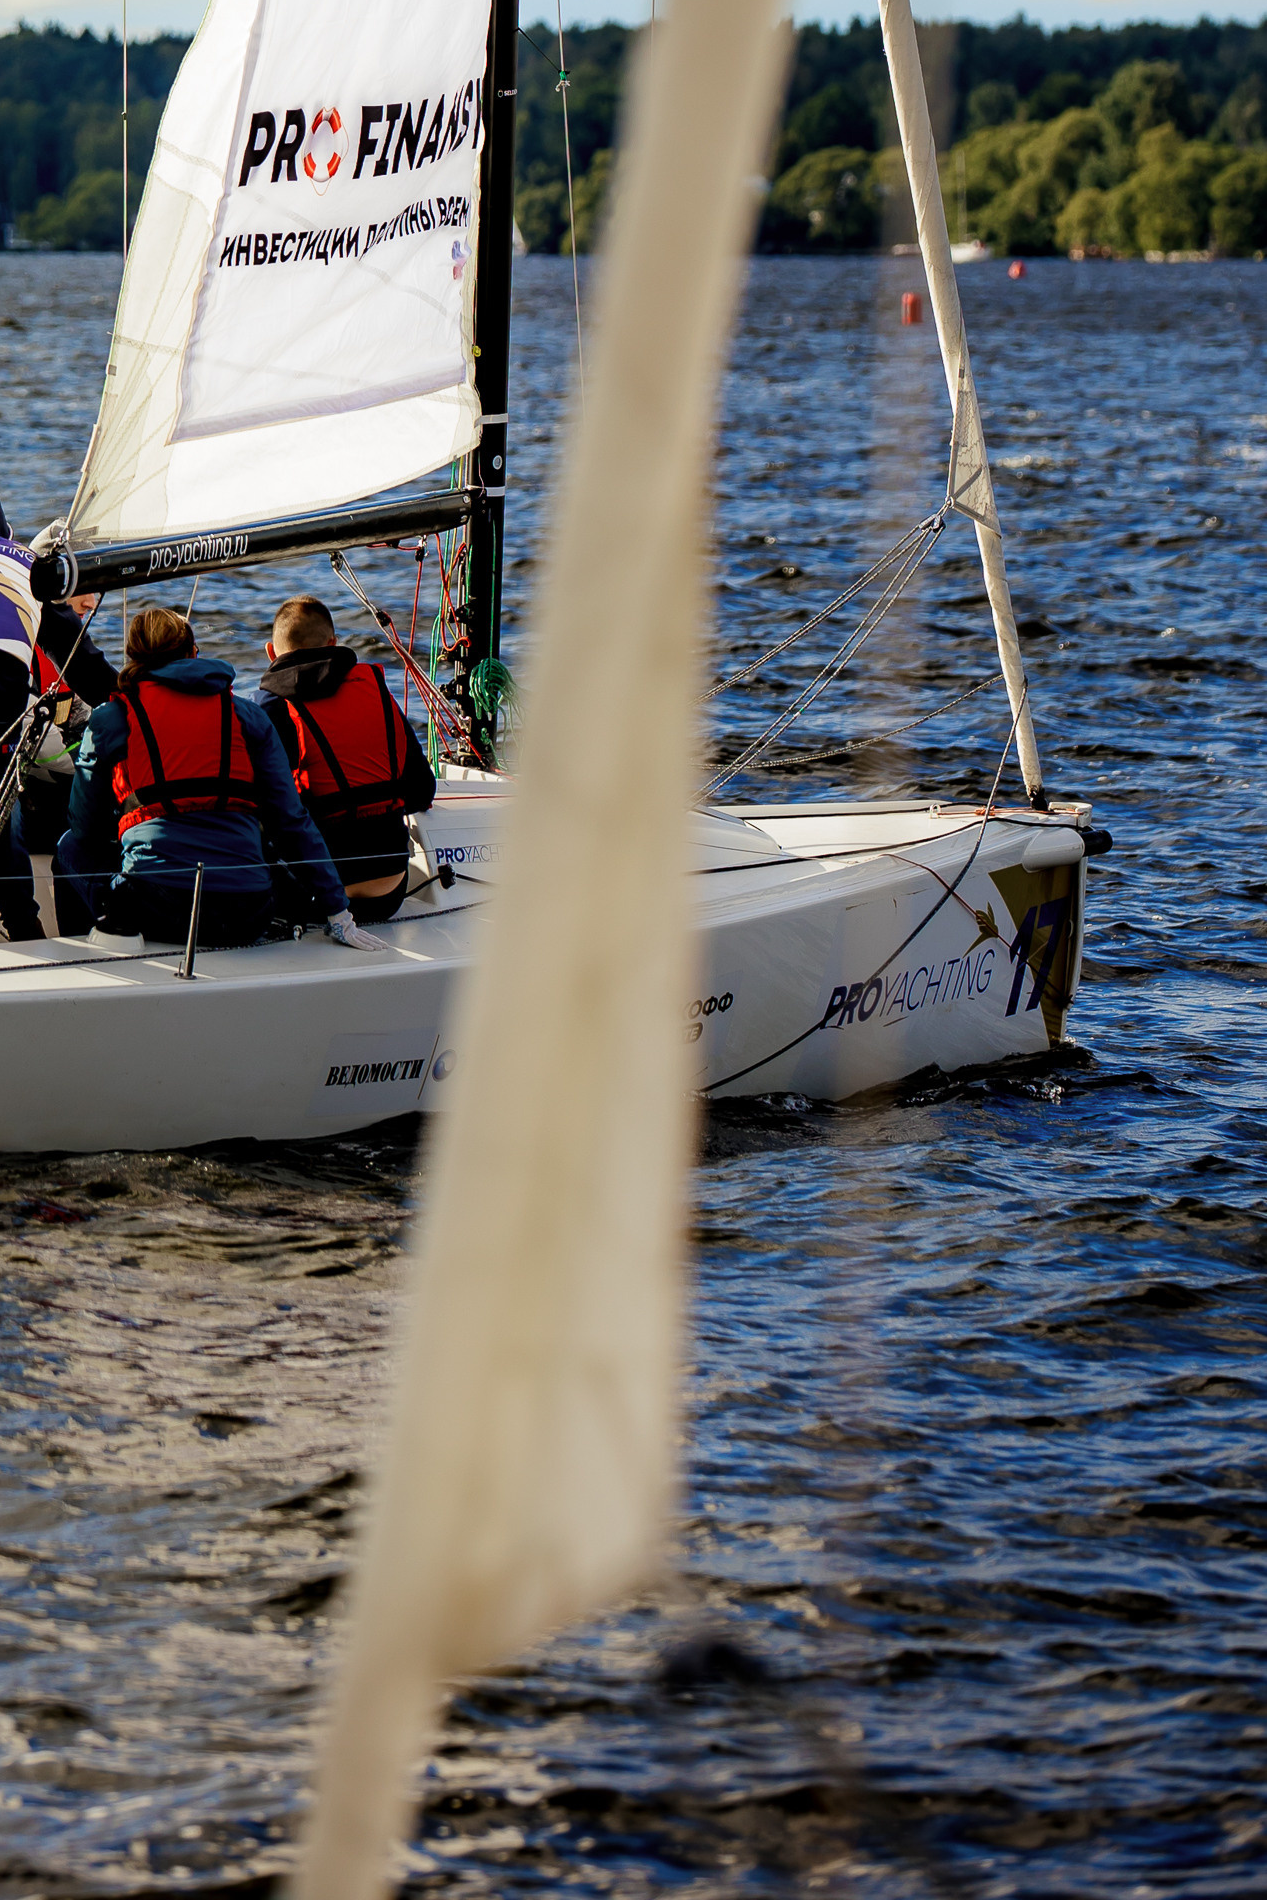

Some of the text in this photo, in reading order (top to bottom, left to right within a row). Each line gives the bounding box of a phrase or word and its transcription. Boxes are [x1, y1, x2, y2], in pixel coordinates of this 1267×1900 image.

[219, 226, 361, 268] ИНВЕСТИЦИИ
[435, 195, 471, 228] ВСЕМ
[146, 534, 249, 578] pro-yachting.ru
[820, 949, 996, 1030] PROYACHTING
[1005, 897, 1069, 1018] 17
[324, 1058, 425, 1089] ВЕДОМОСТИ
